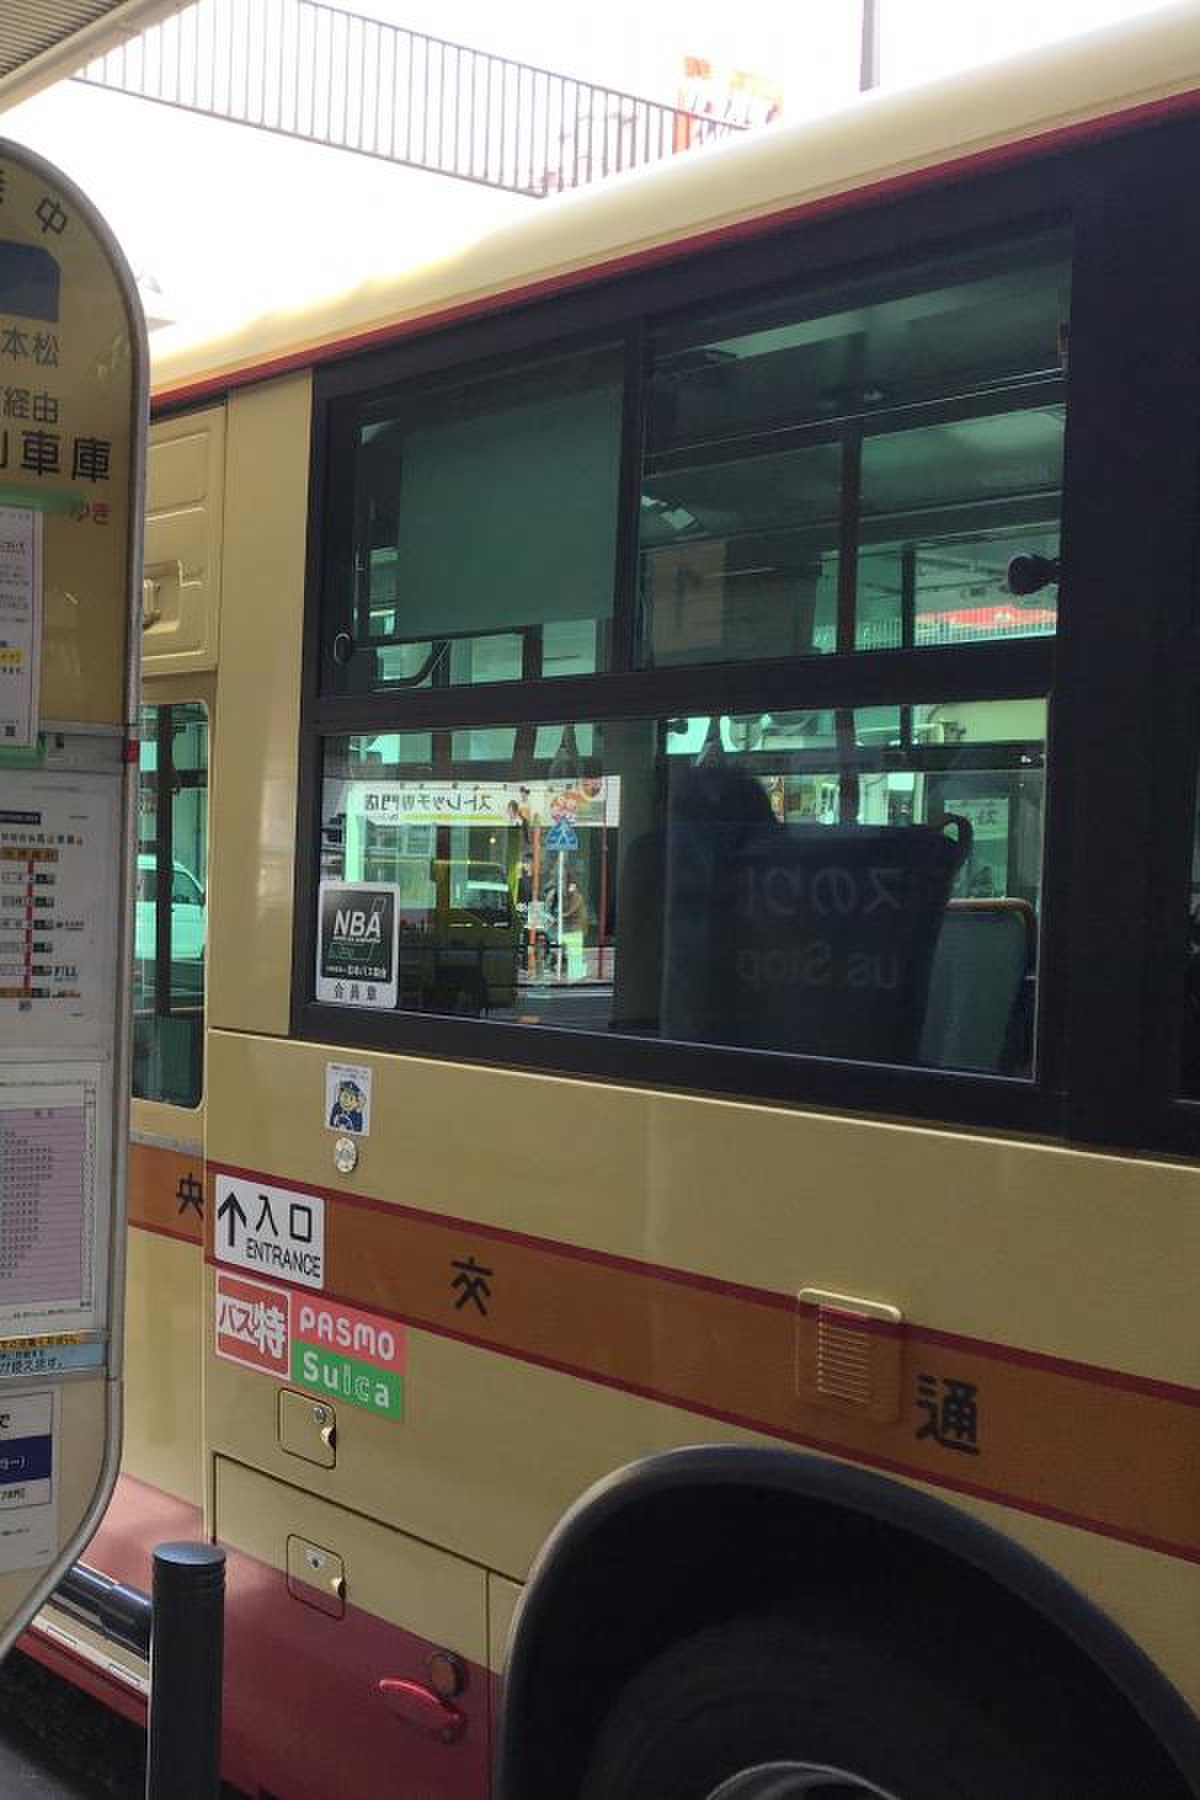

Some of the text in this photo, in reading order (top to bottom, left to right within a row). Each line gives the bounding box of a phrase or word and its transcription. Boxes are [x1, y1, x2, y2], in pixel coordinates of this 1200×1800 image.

[334, 910, 381, 938] NBA
[255, 1195, 313, 1243] 入口
[246, 1237, 321, 1279] ENTRANCE
[176, 1171, 981, 1456] 央 交 通
[217, 1301, 286, 1360] バス特
[299, 1306, 395, 1361] PASMO
[302, 1350, 391, 1409] Suica
